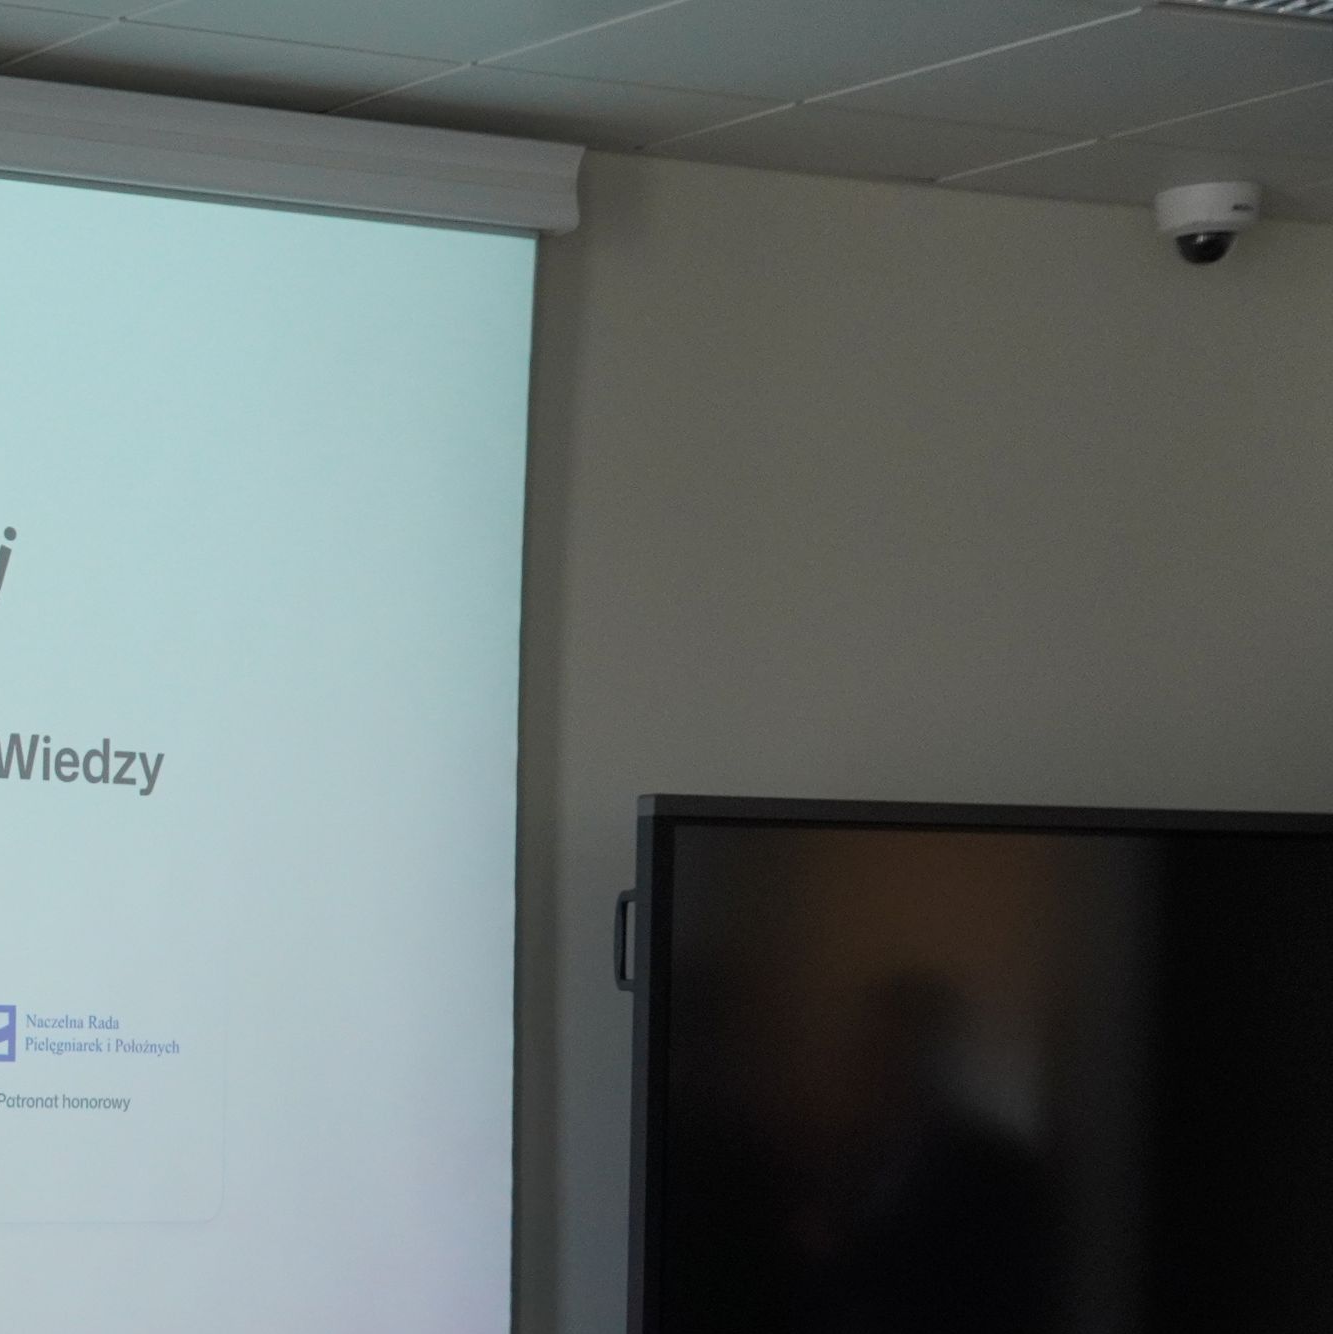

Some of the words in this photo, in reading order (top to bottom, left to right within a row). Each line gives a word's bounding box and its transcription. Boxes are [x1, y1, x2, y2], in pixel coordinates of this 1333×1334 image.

[26, 1013, 84, 1031] Naczelna
[88, 1014, 121, 1031] Rada
[24, 1036, 103, 1057] Pielęgniarek
[107, 1038, 112, 1054] i
[115, 1038, 181, 1058] Położnych
[61, 1094, 132, 1113] honorowy
